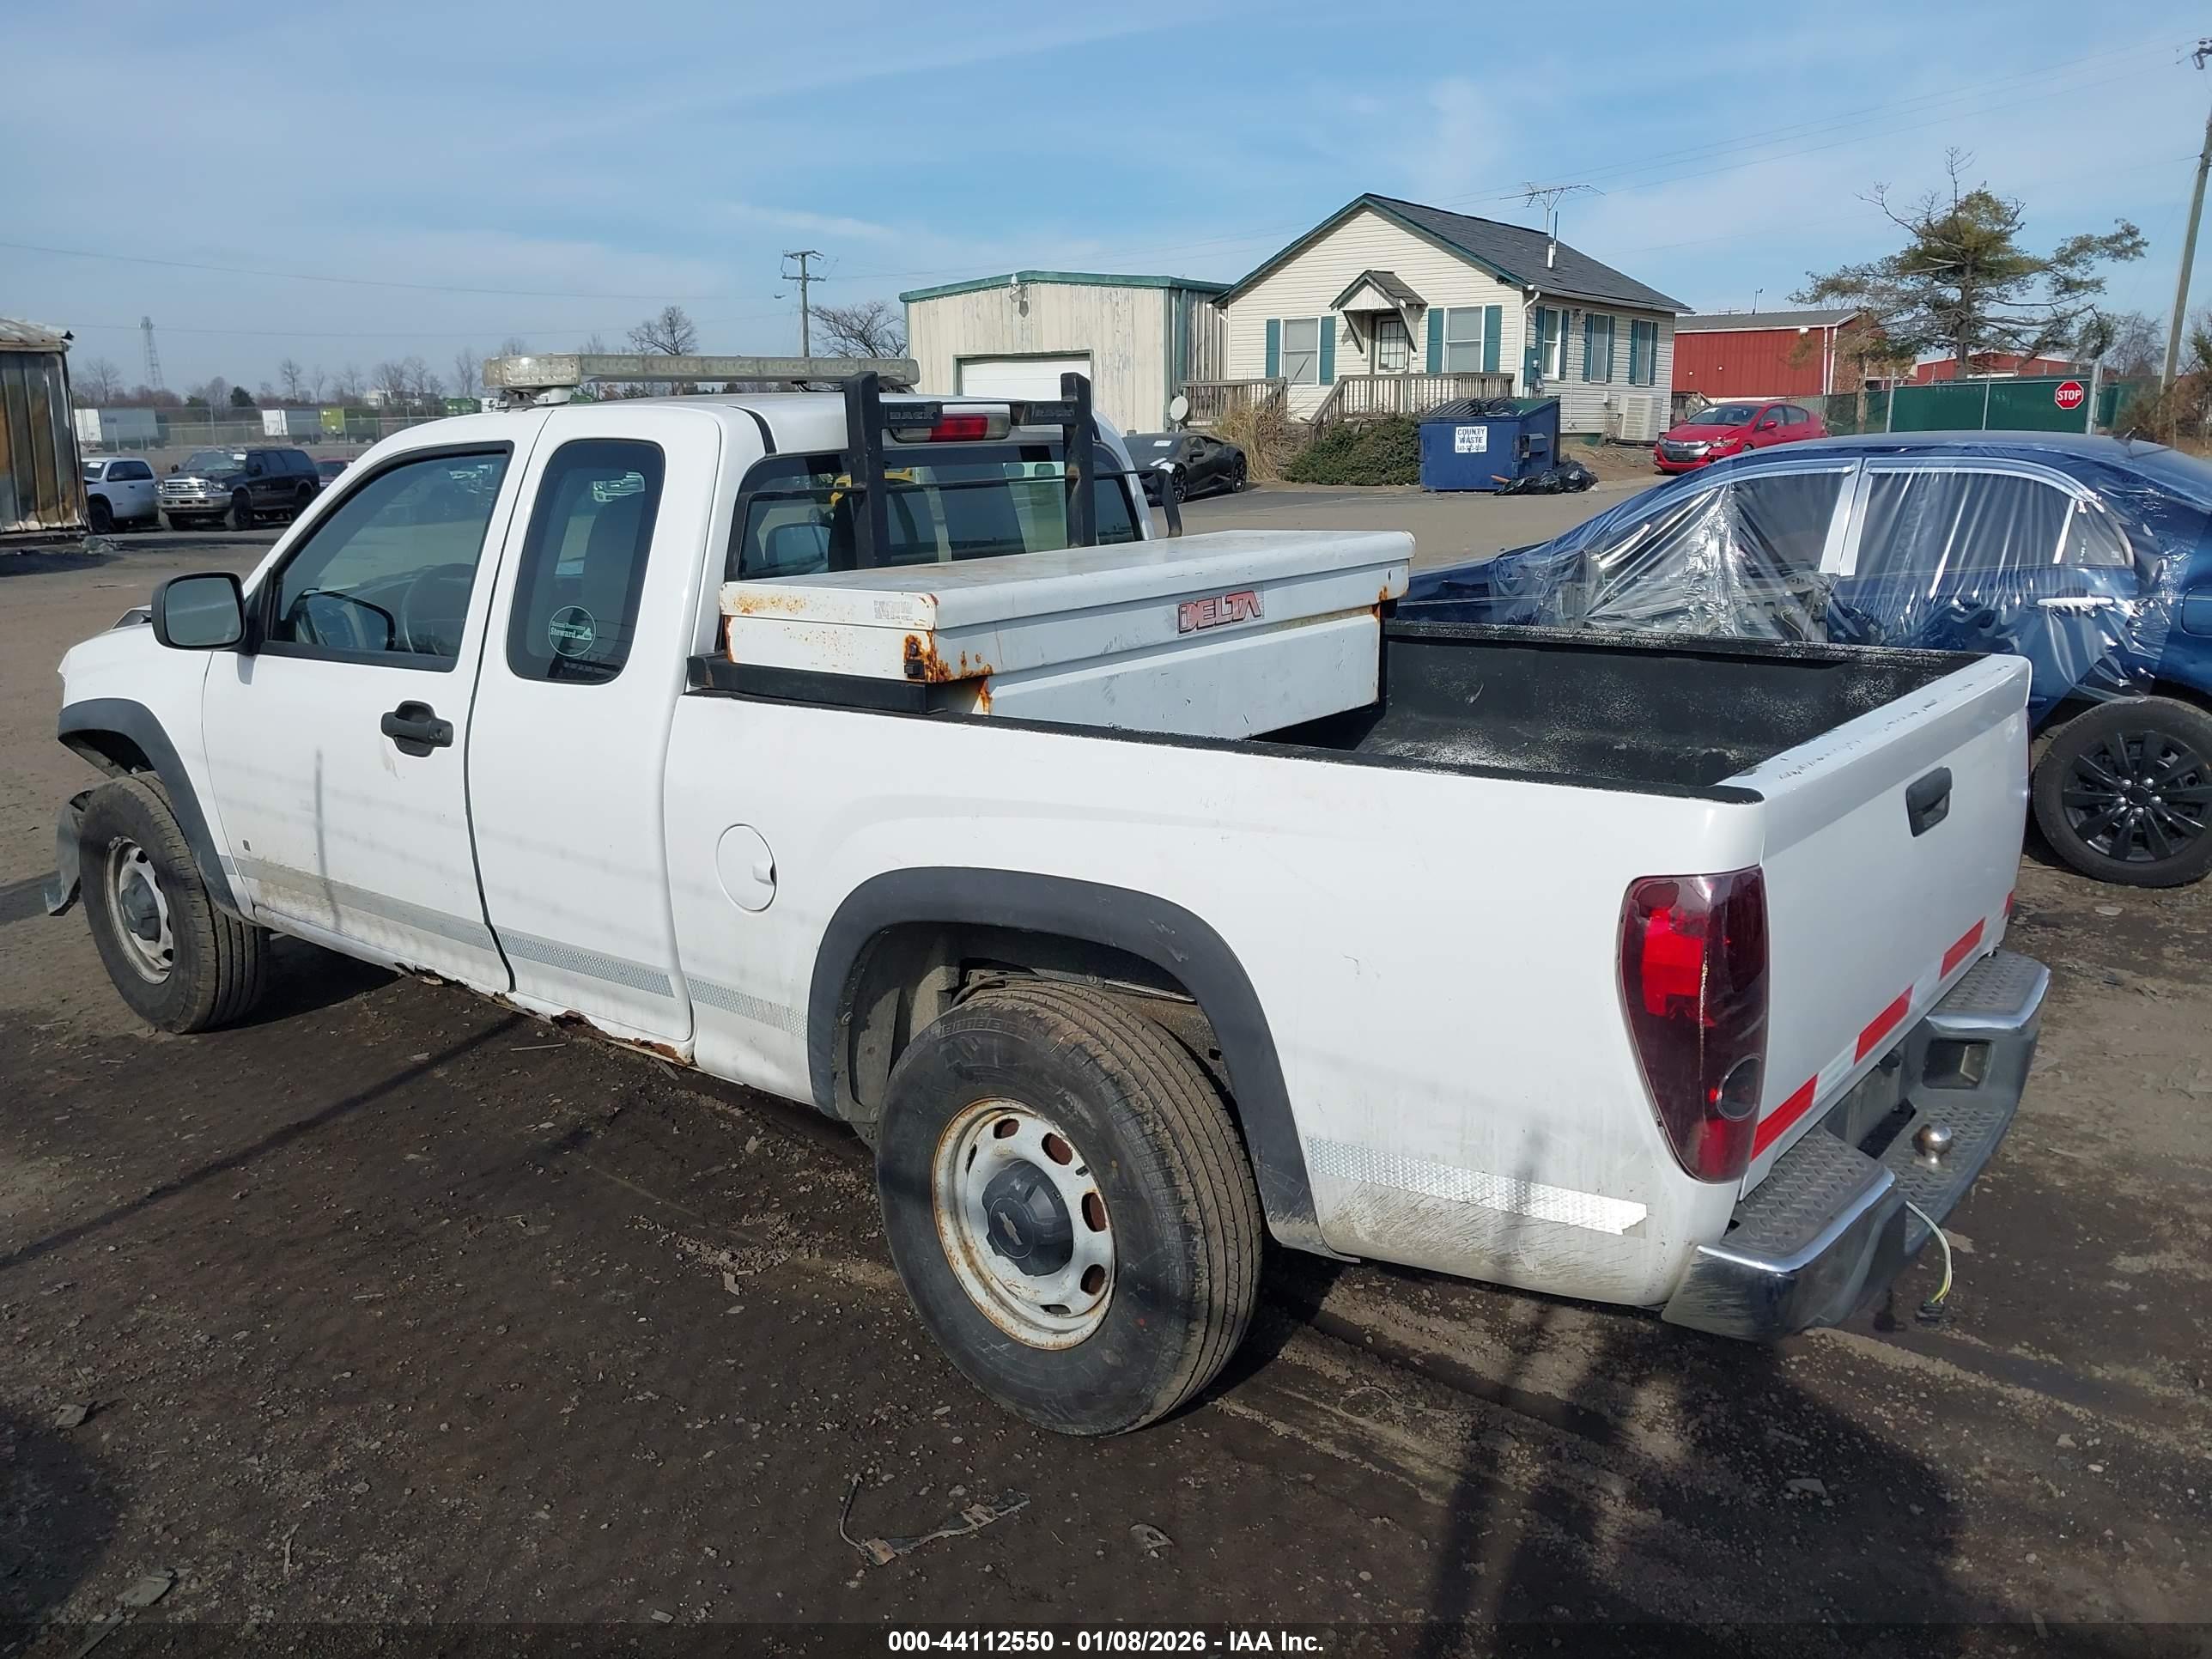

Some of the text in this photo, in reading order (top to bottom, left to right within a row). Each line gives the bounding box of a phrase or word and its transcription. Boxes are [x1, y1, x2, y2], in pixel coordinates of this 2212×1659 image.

[2057, 390, 2081, 401] STOP
[1178, 590, 1261, 634] DELTA
[550, 627, 576, 638] Steward
